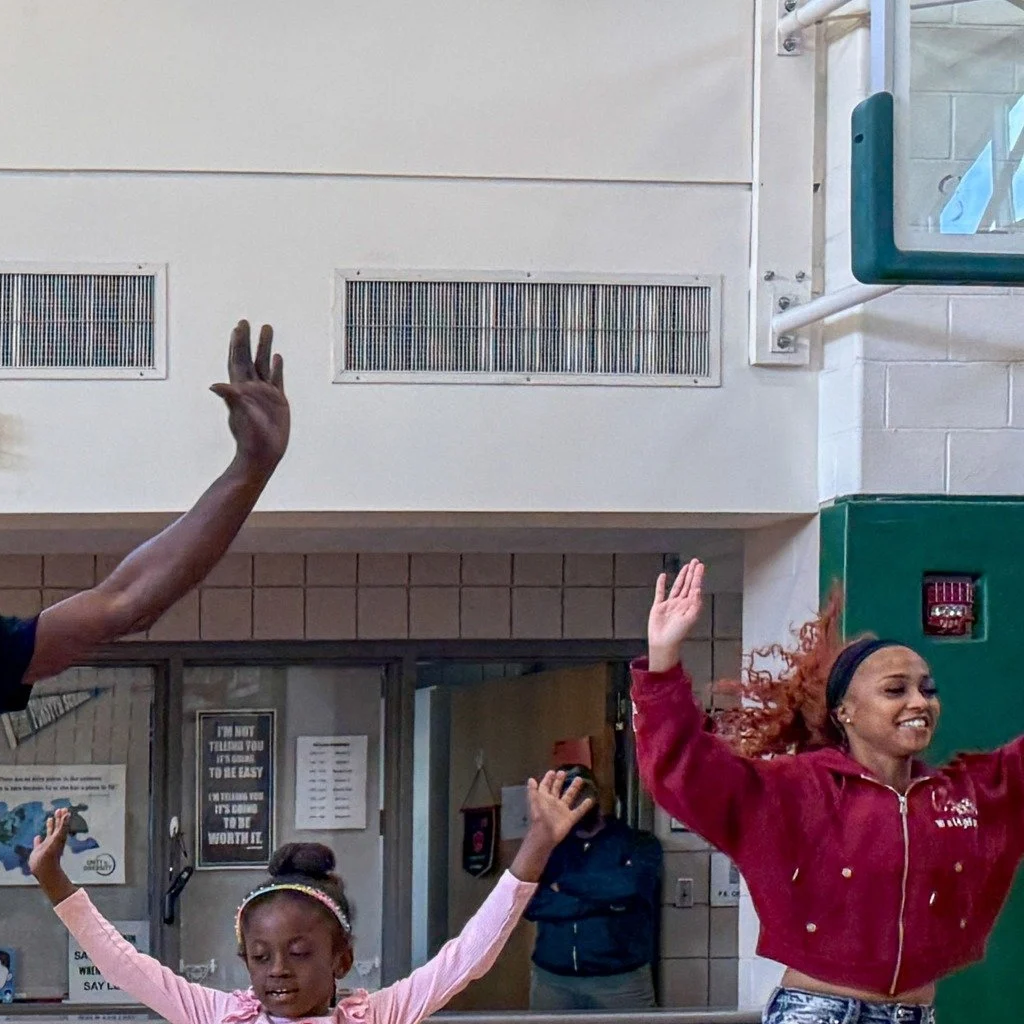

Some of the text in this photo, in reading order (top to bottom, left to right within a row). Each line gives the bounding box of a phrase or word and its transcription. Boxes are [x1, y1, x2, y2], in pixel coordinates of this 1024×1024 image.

[217, 725, 255, 738] I'M NOT
[209, 740, 264, 752] TELLING YOU
[216, 754, 255, 764] IT'S GOING
[209, 766, 263, 779] TO BE EASY
[220, 792, 248, 801] TELLING
[249, 792, 264, 801] YOU
[214, 803, 258, 815] IT'S GOING
[223, 816, 252, 829] TO BE
[208, 831, 249, 845] WORTH
[74, 951, 89, 960] SA
[84, 982, 105, 990] SAY
